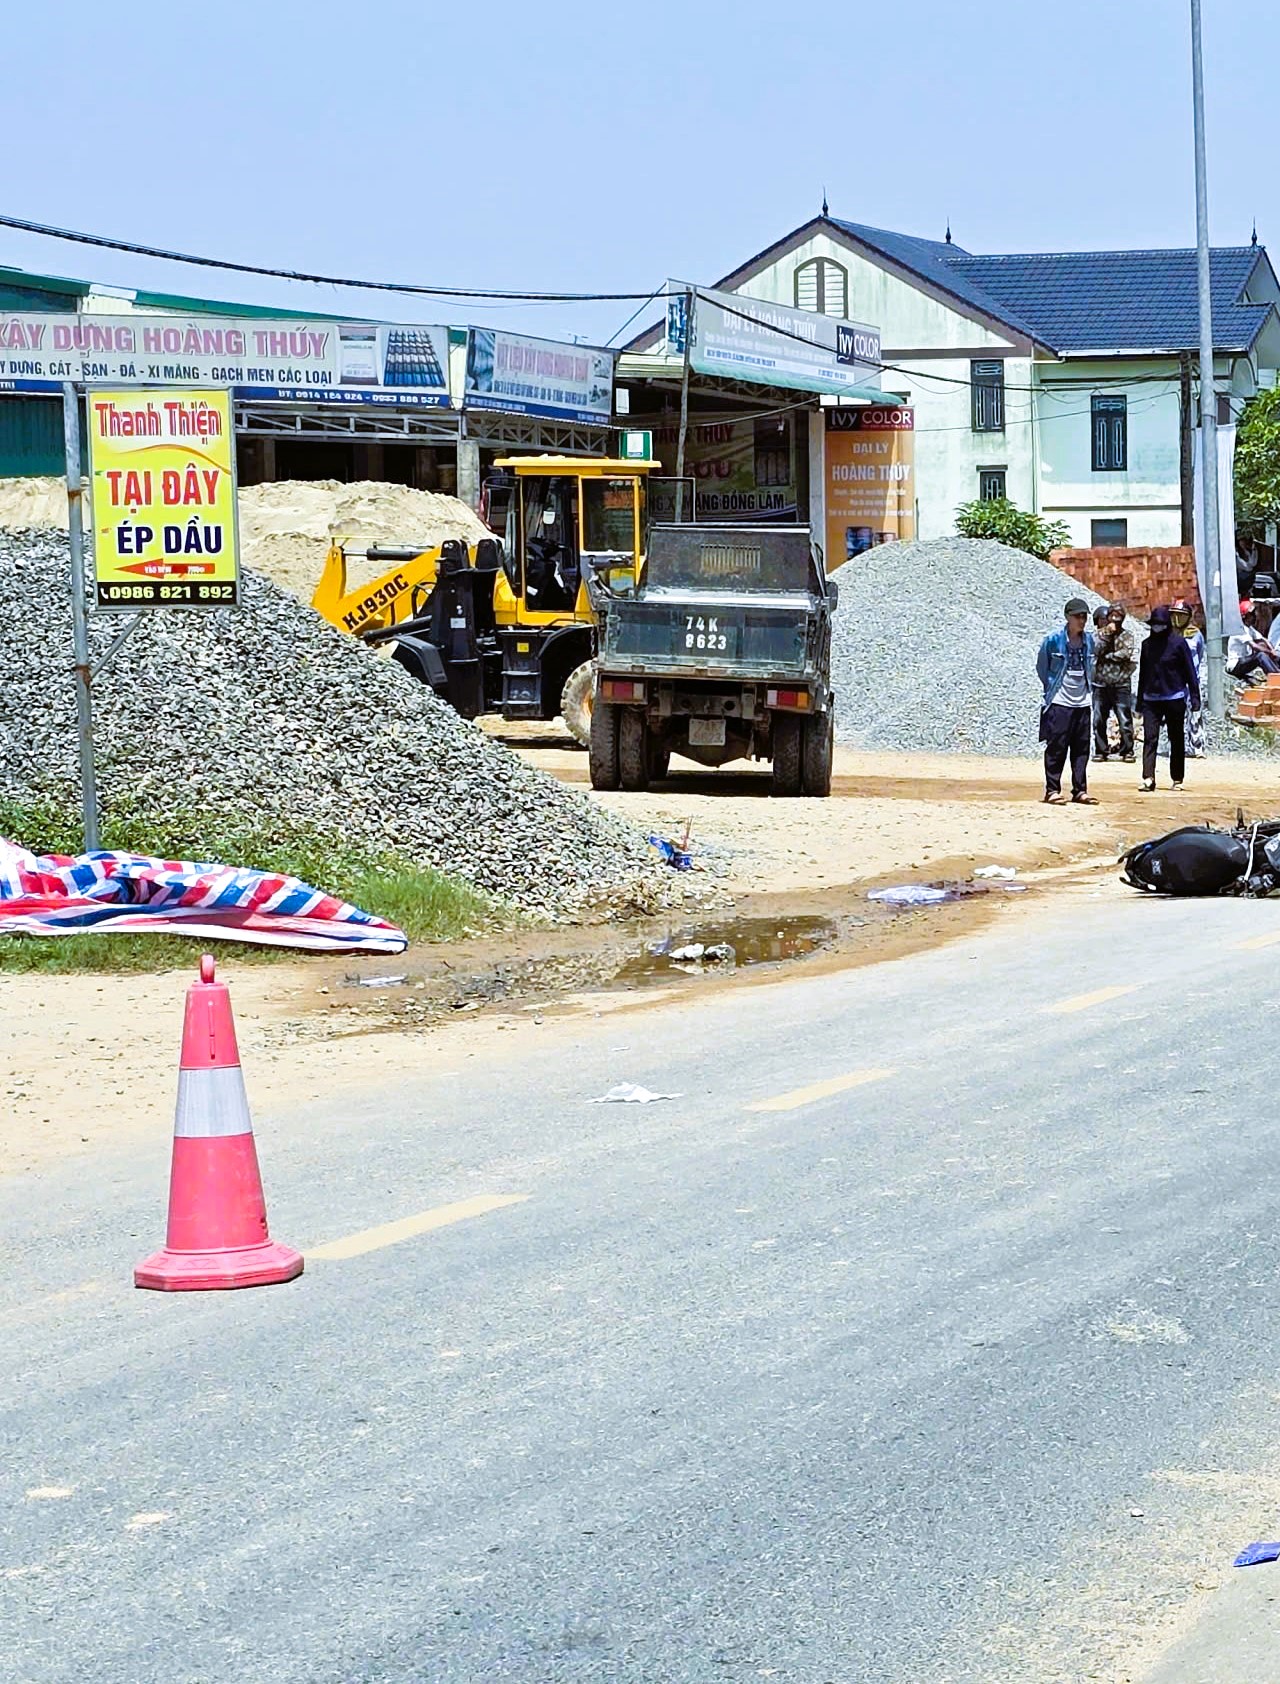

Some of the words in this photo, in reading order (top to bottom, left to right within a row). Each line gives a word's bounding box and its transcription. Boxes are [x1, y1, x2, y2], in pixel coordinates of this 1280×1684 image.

[53, 323, 136, 358] DỰNG
[143, 322, 246, 357] HOÀNG
[253, 326, 329, 360] THÚY
[853, 334, 880, 360] COLOR
[50, 360, 72, 376] CÁT
[119, 361, 136, 377] ĐÁ
[148, 365, 160, 378] XI
[212, 367, 243, 383] GẠCH
[247, 368, 275, 382] MEN
[278, 366, 302, 383] CÁC
[305, 370, 332, 387] LOẠI
[94, 402, 162, 438] Thanh
[163, 401, 223, 445] Thiện
[862, 411, 912, 425] COLOR
[832, 461, 876, 481] HOÀNG
[106, 470, 152, 513] TẠI
[162, 462, 220, 505] ĐÂY
[117, 520, 154, 554] ÉP
[164, 515, 222, 554] DẦU
[110, 586, 154, 599] 0986
[160, 586, 191, 599] 821
[199, 586, 233, 599] 892
[342, 573, 410, 631] HJ930C
